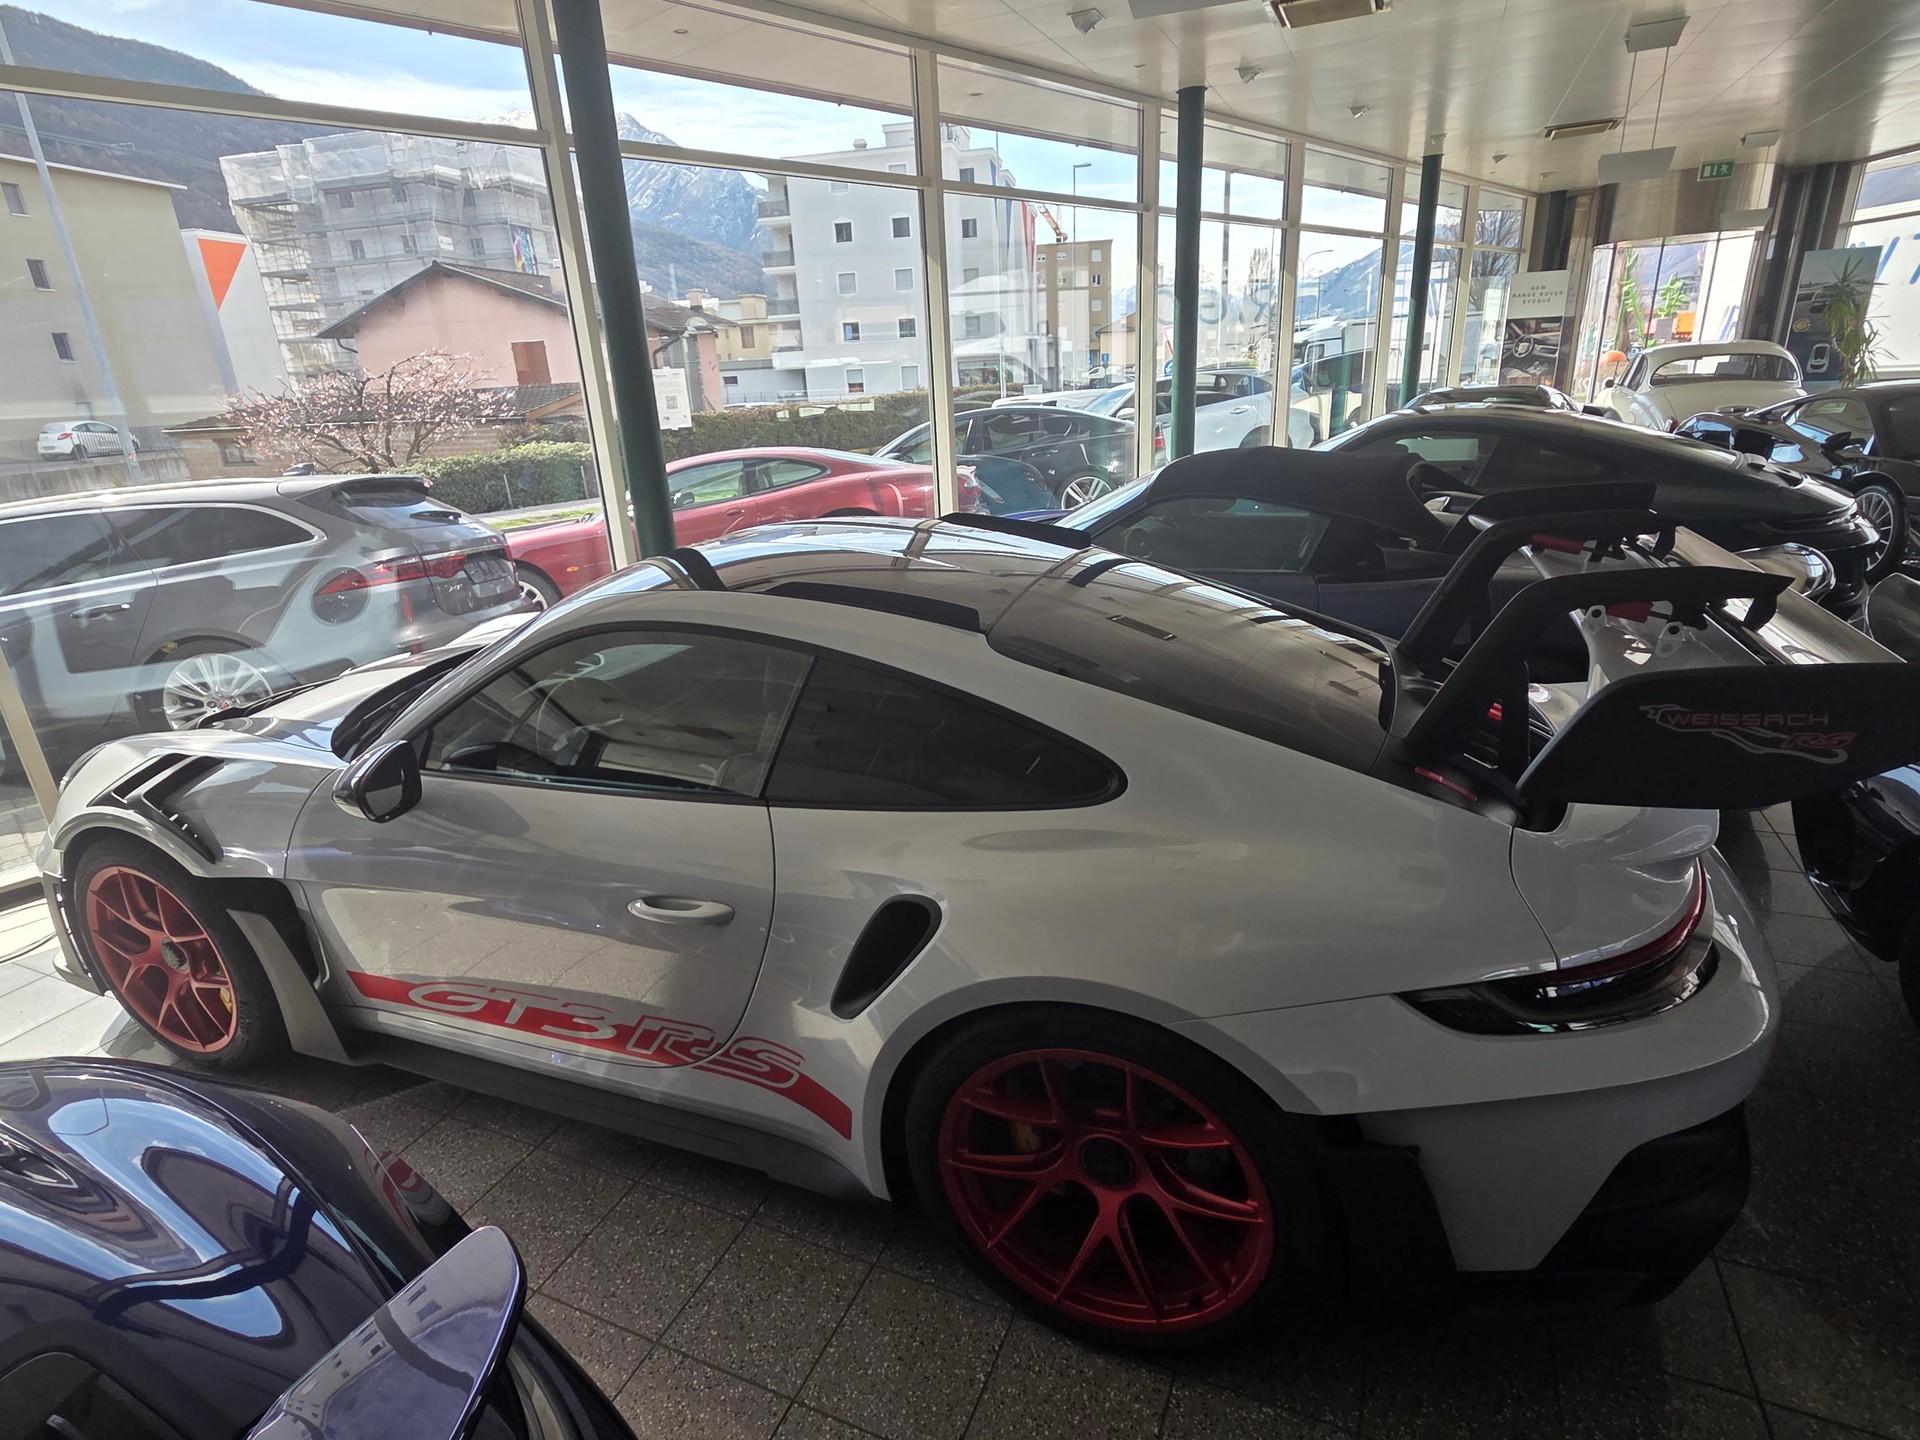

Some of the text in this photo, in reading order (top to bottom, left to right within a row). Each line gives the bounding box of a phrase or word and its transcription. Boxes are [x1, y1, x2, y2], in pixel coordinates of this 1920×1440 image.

[1539, 289, 1563, 297] ROVER
[1667, 713, 1829, 727] WEISSACH
[1781, 732, 1855, 748] RS
